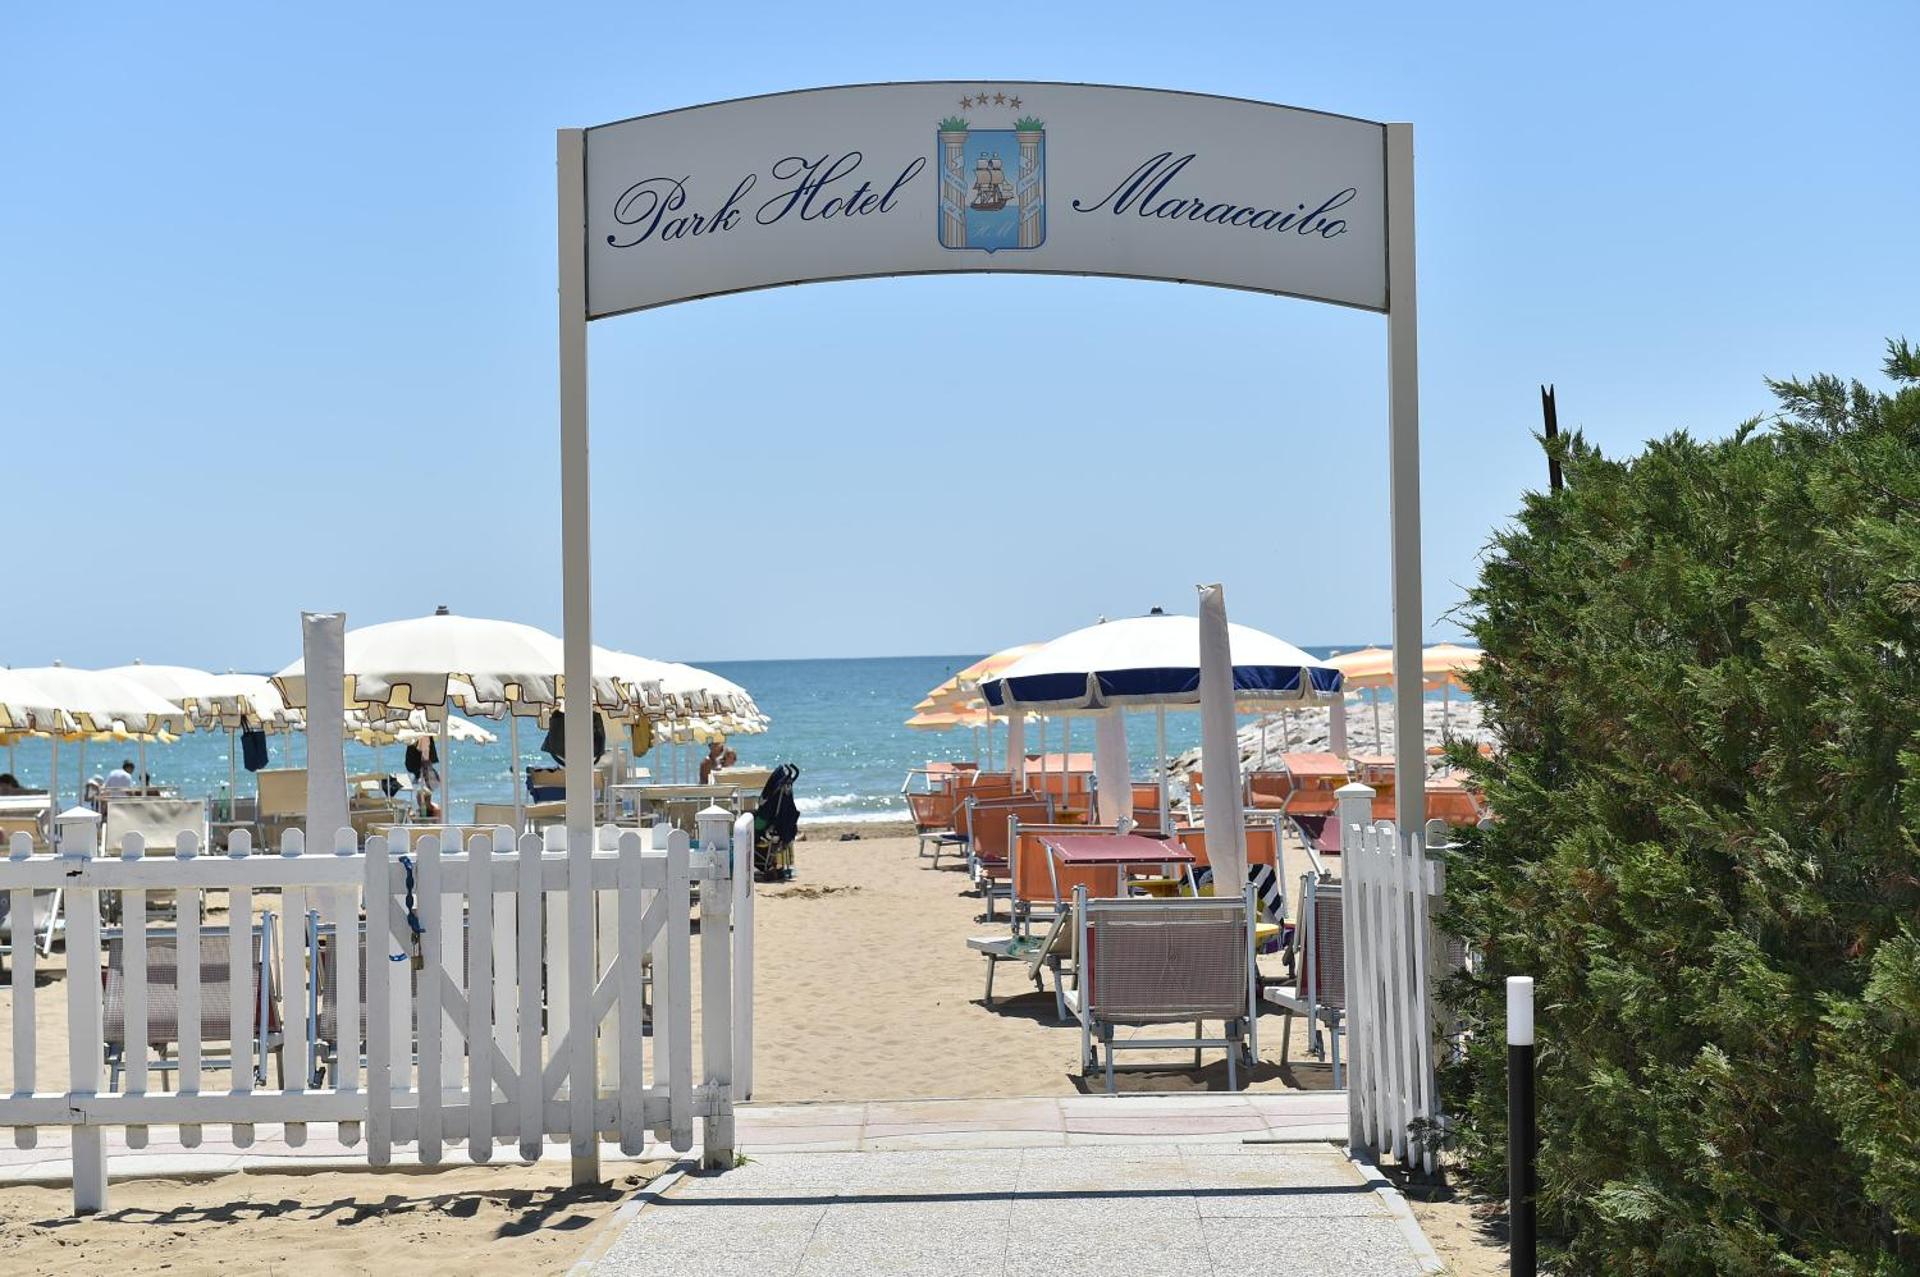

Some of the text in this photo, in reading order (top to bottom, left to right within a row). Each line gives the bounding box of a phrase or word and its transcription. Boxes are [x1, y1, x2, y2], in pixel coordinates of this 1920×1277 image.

[606, 150, 1358, 248] Park Hotel Maracaibo
